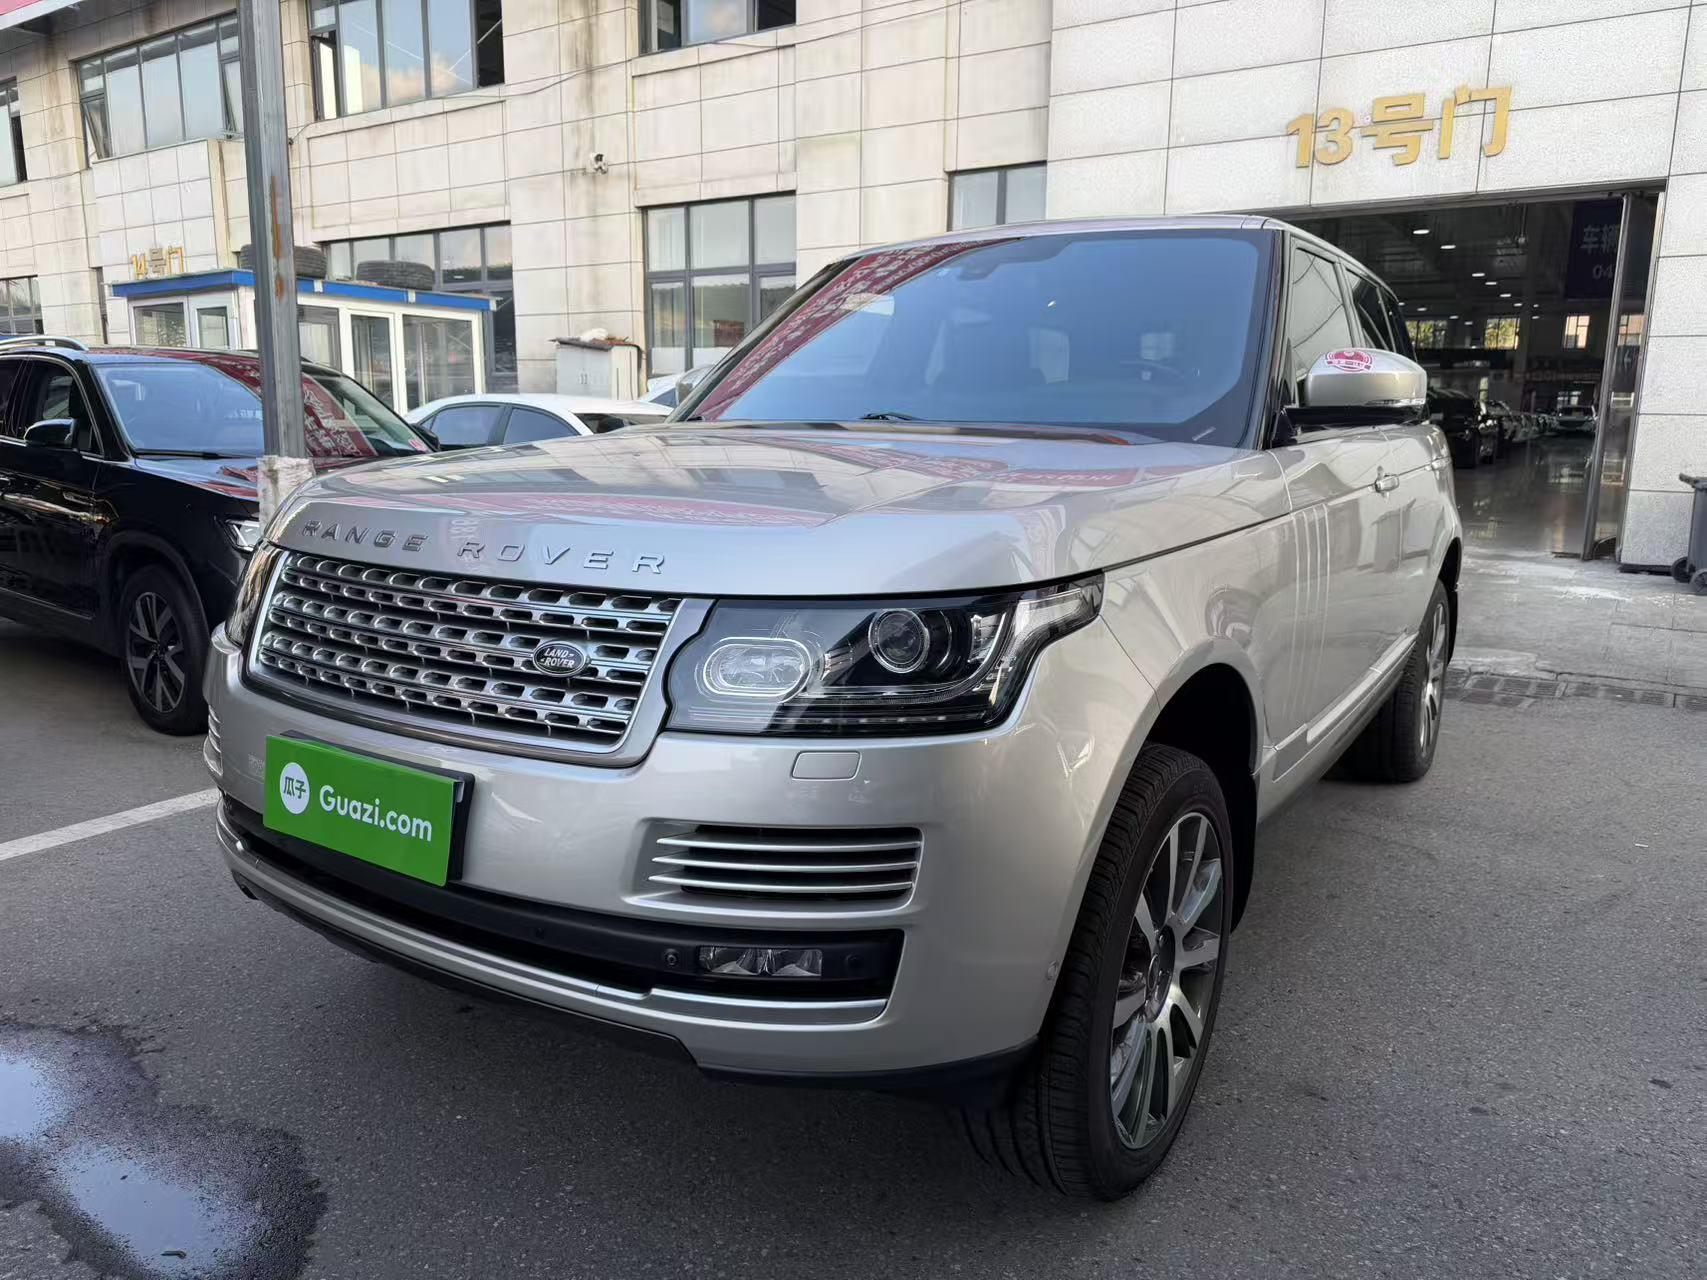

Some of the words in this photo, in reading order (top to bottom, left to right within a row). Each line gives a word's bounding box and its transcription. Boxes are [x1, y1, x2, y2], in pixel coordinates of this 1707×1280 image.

[1287, 84, 1513, 168] 13号门
[130, 245, 185, 279] 14号门
[301, 520, 429, 552] RANGE
[457, 541, 665, 575] ROVER
[283, 775, 307, 800] 瓜子
[319, 784, 433, 842] Guazi.com
